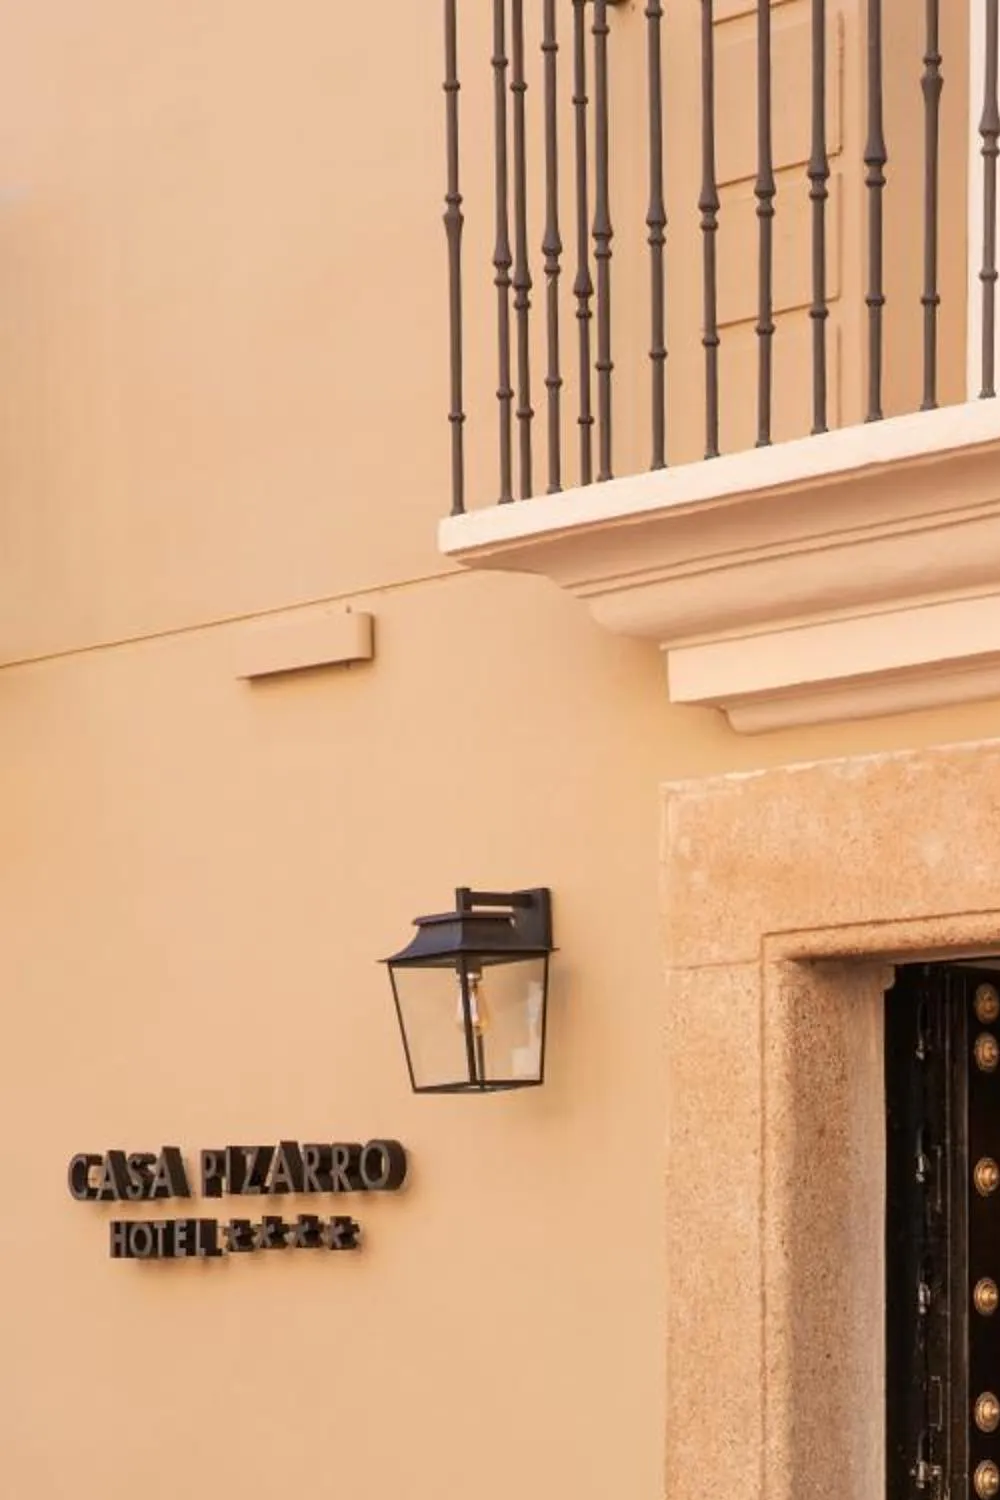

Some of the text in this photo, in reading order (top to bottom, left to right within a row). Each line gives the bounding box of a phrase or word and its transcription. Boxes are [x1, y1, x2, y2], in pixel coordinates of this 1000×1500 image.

[68, 1140, 408, 1200] CASA PIZARRO
[109, 1218, 223, 1258] HOTEL
